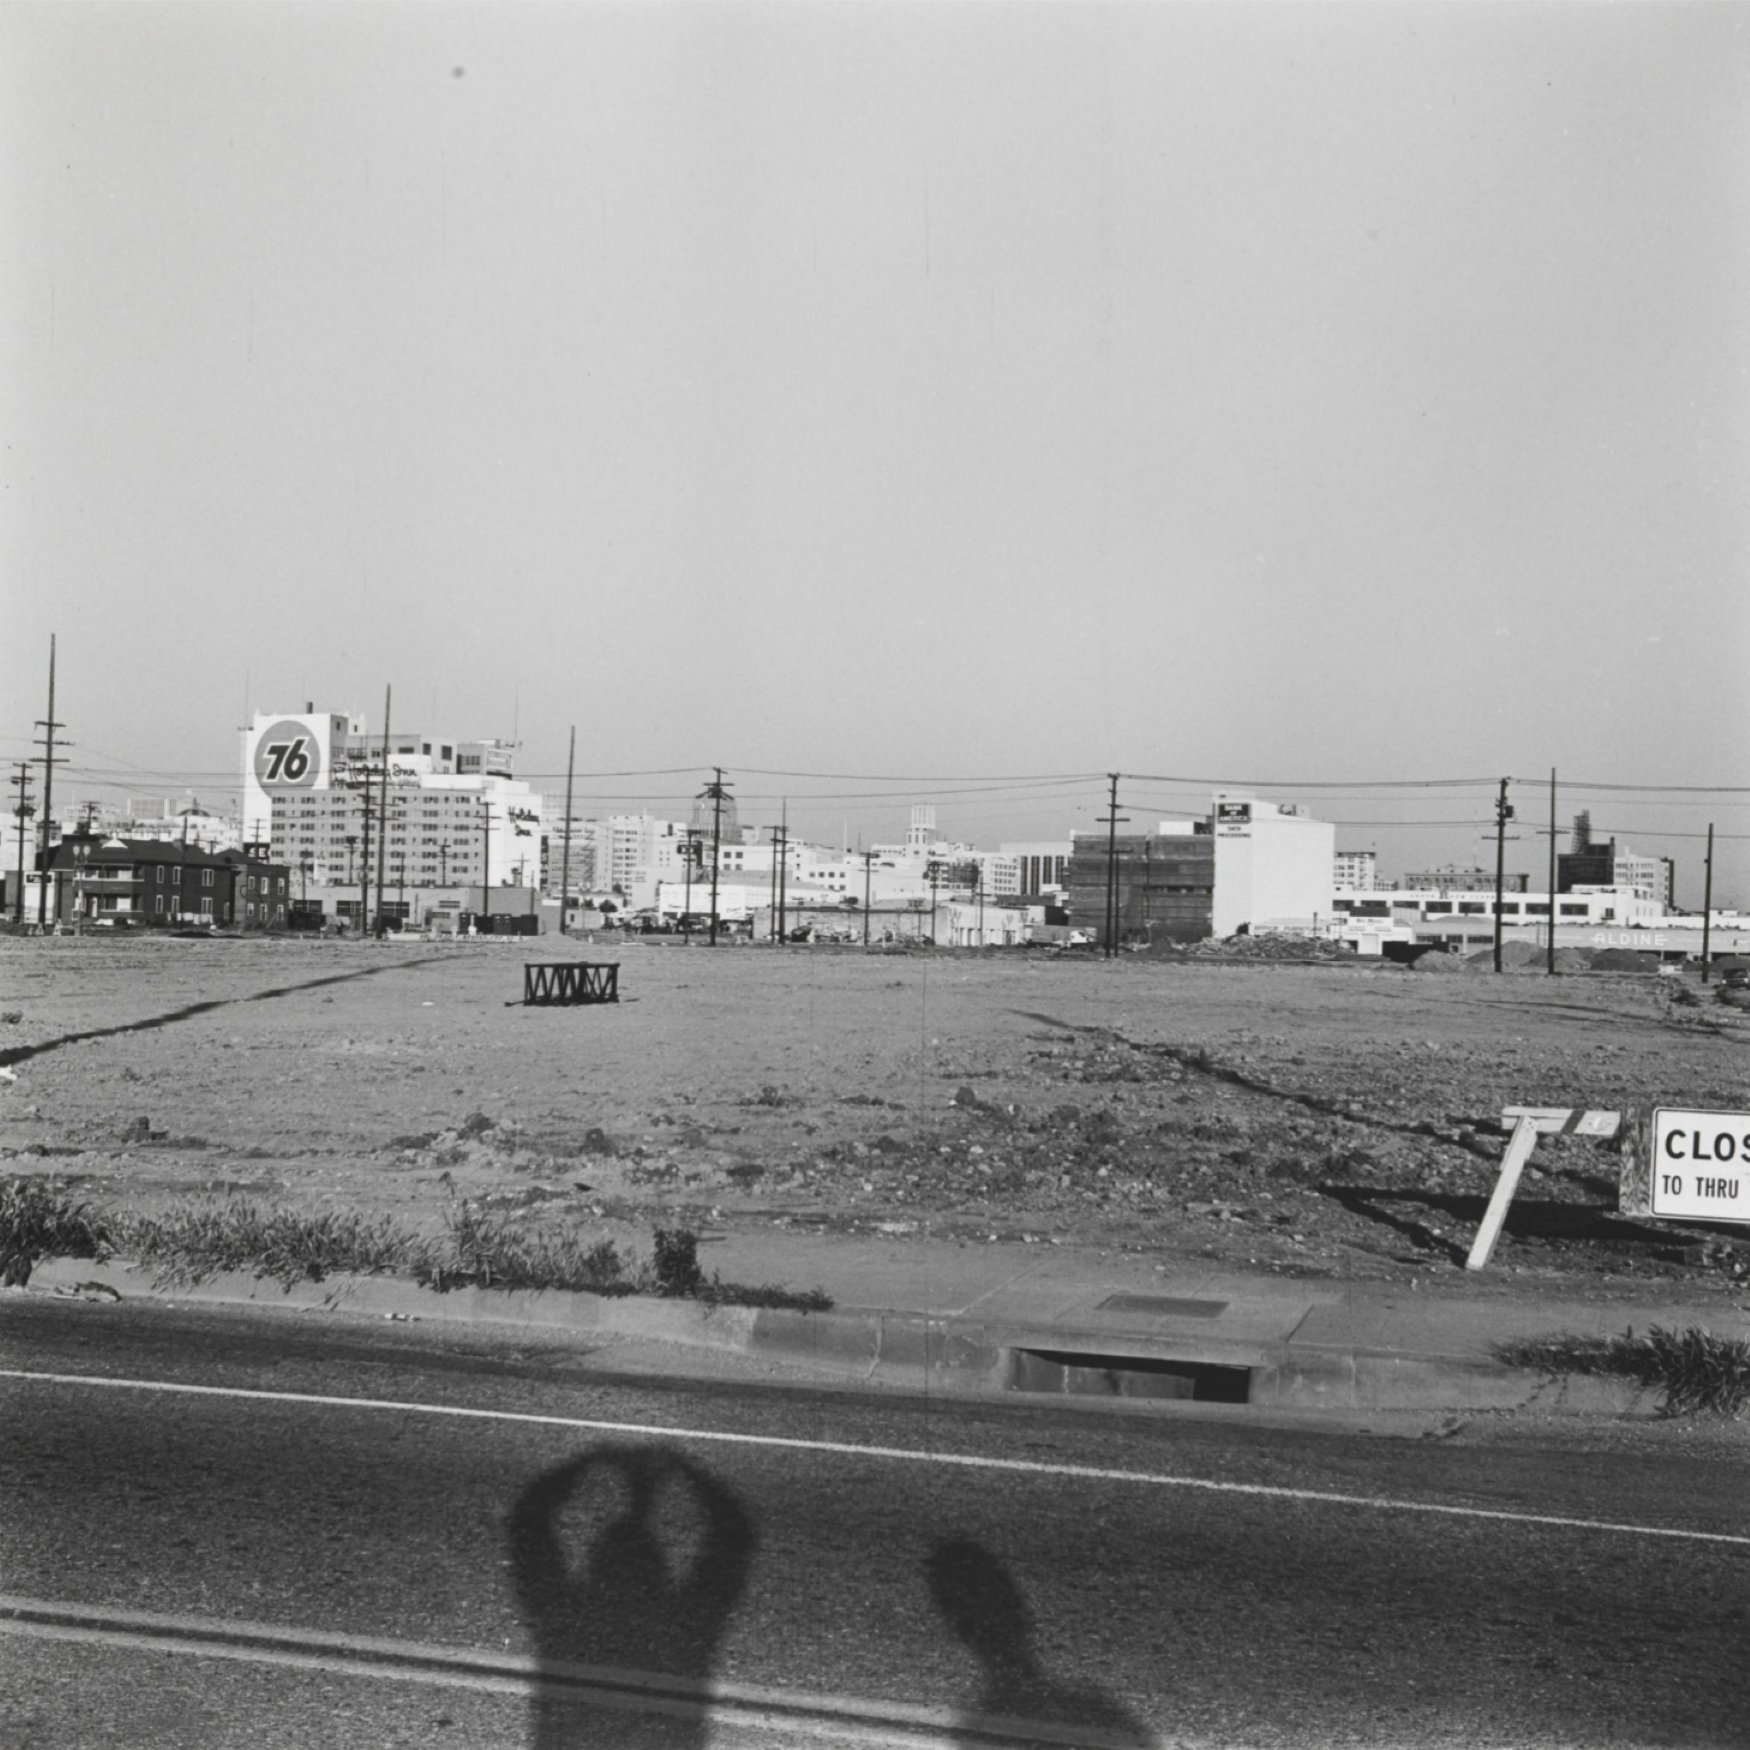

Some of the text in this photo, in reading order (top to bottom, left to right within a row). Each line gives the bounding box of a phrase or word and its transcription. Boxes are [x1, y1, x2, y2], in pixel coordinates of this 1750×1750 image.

[263, 736, 309, 782] 76
[1592, 932, 1668, 946] ALDINE
[1662, 1174, 1739, 1199] TO THRU
